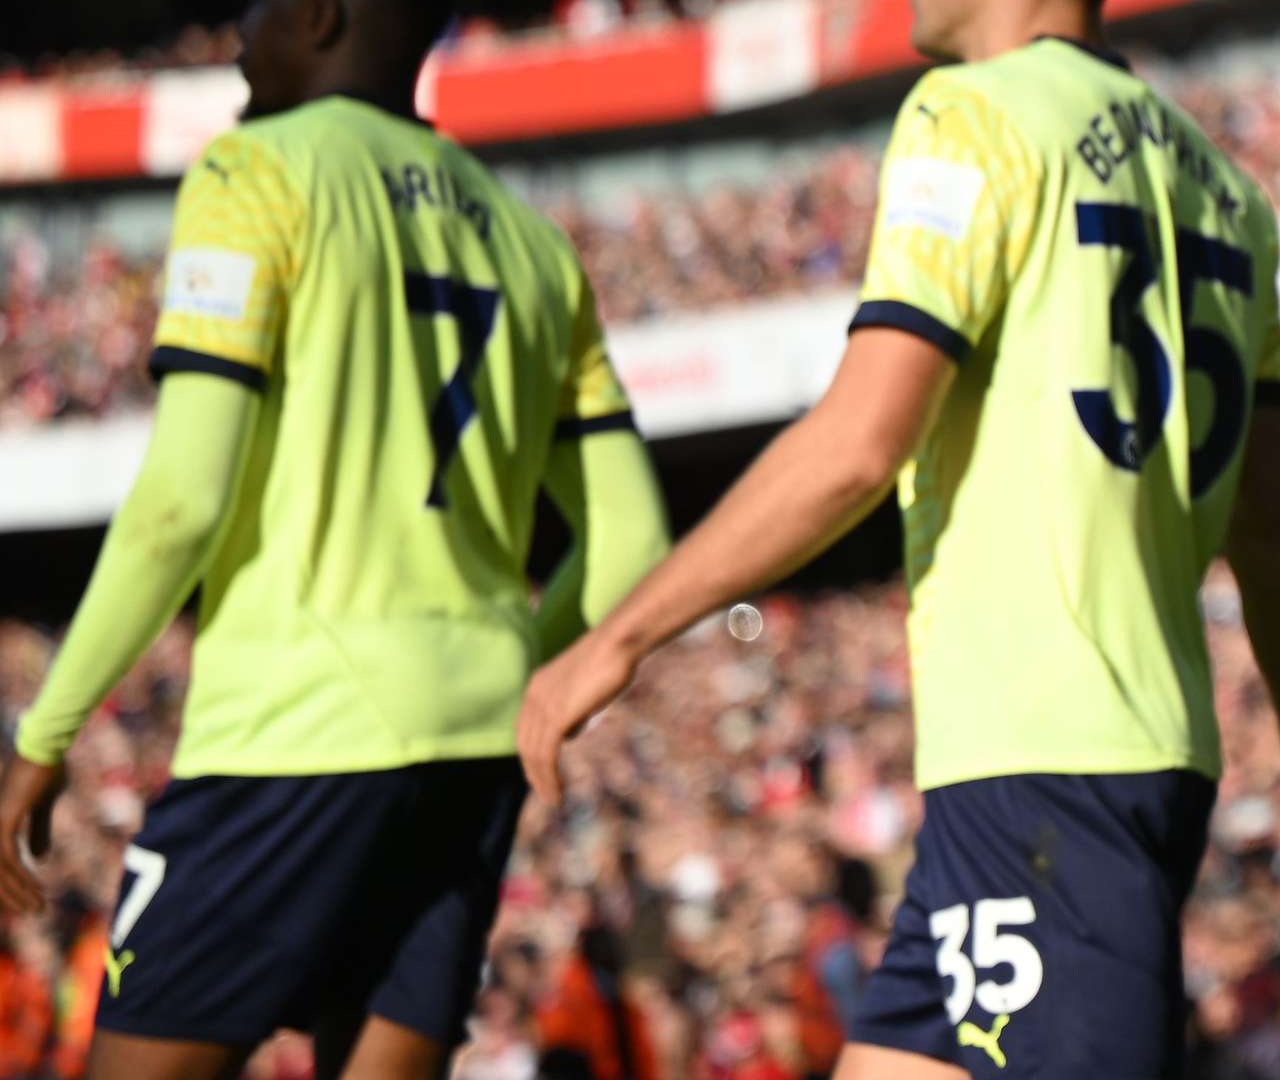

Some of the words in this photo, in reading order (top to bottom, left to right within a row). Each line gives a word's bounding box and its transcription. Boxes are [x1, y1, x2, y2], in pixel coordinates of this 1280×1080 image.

[403, 270, 500, 509] 7
[1071, 202, 1253, 501] 35
[112, 843, 167, 950] 7
[929, 896, 1043, 1025] 35
